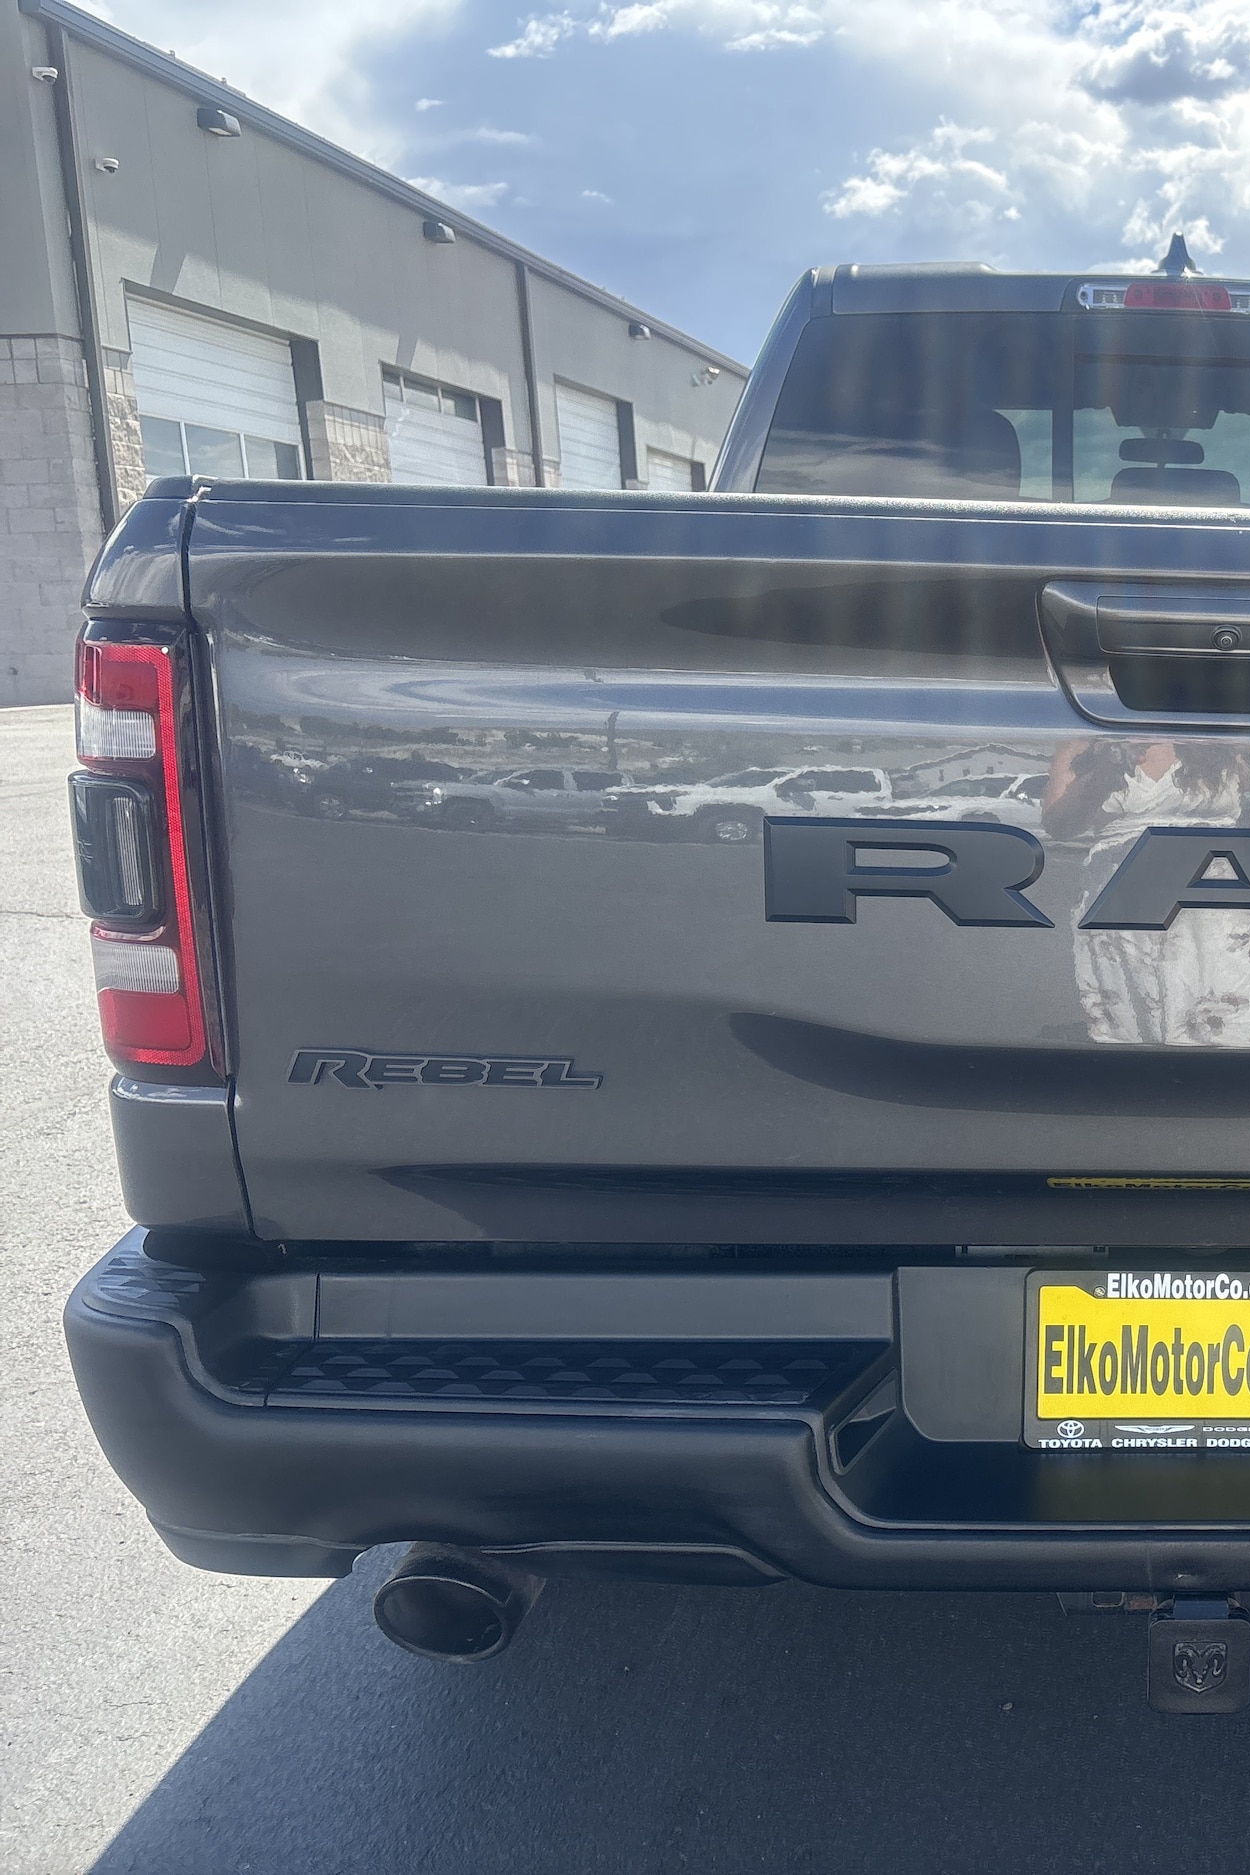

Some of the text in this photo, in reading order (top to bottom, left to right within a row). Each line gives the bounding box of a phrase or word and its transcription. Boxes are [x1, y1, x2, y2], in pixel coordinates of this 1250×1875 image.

[287, 1047, 604, 1091] REBEL
[1038, 1439, 1103, 1449] TOYOTA
[1111, 1438, 1198, 1449] CHRYSLER
